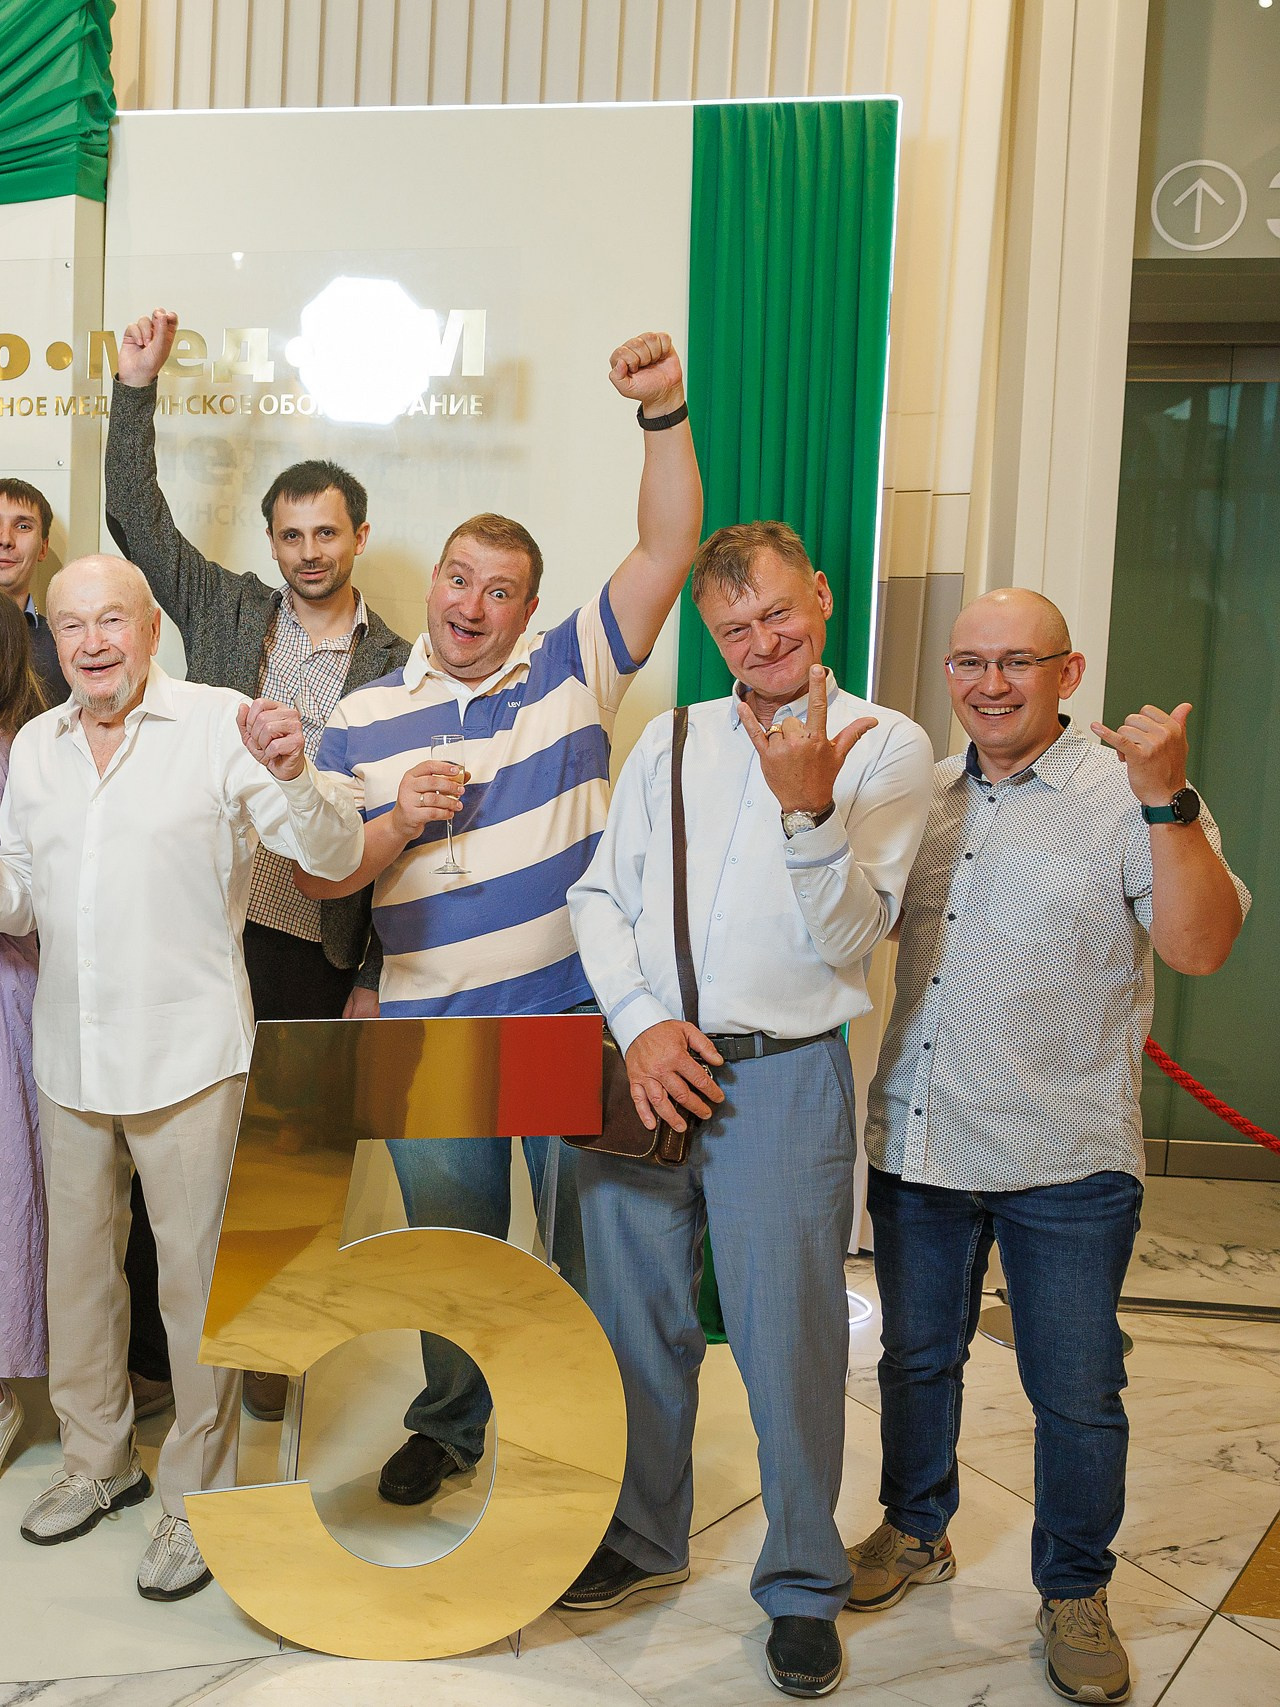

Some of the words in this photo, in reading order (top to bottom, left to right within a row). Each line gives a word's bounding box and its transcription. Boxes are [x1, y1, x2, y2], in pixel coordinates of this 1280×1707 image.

[54, 394, 252, 419] МЕДИНСКОЕ
[259, 393, 483, 416] ОБОАНИЕ
[183, 1013, 628, 1661] 5
